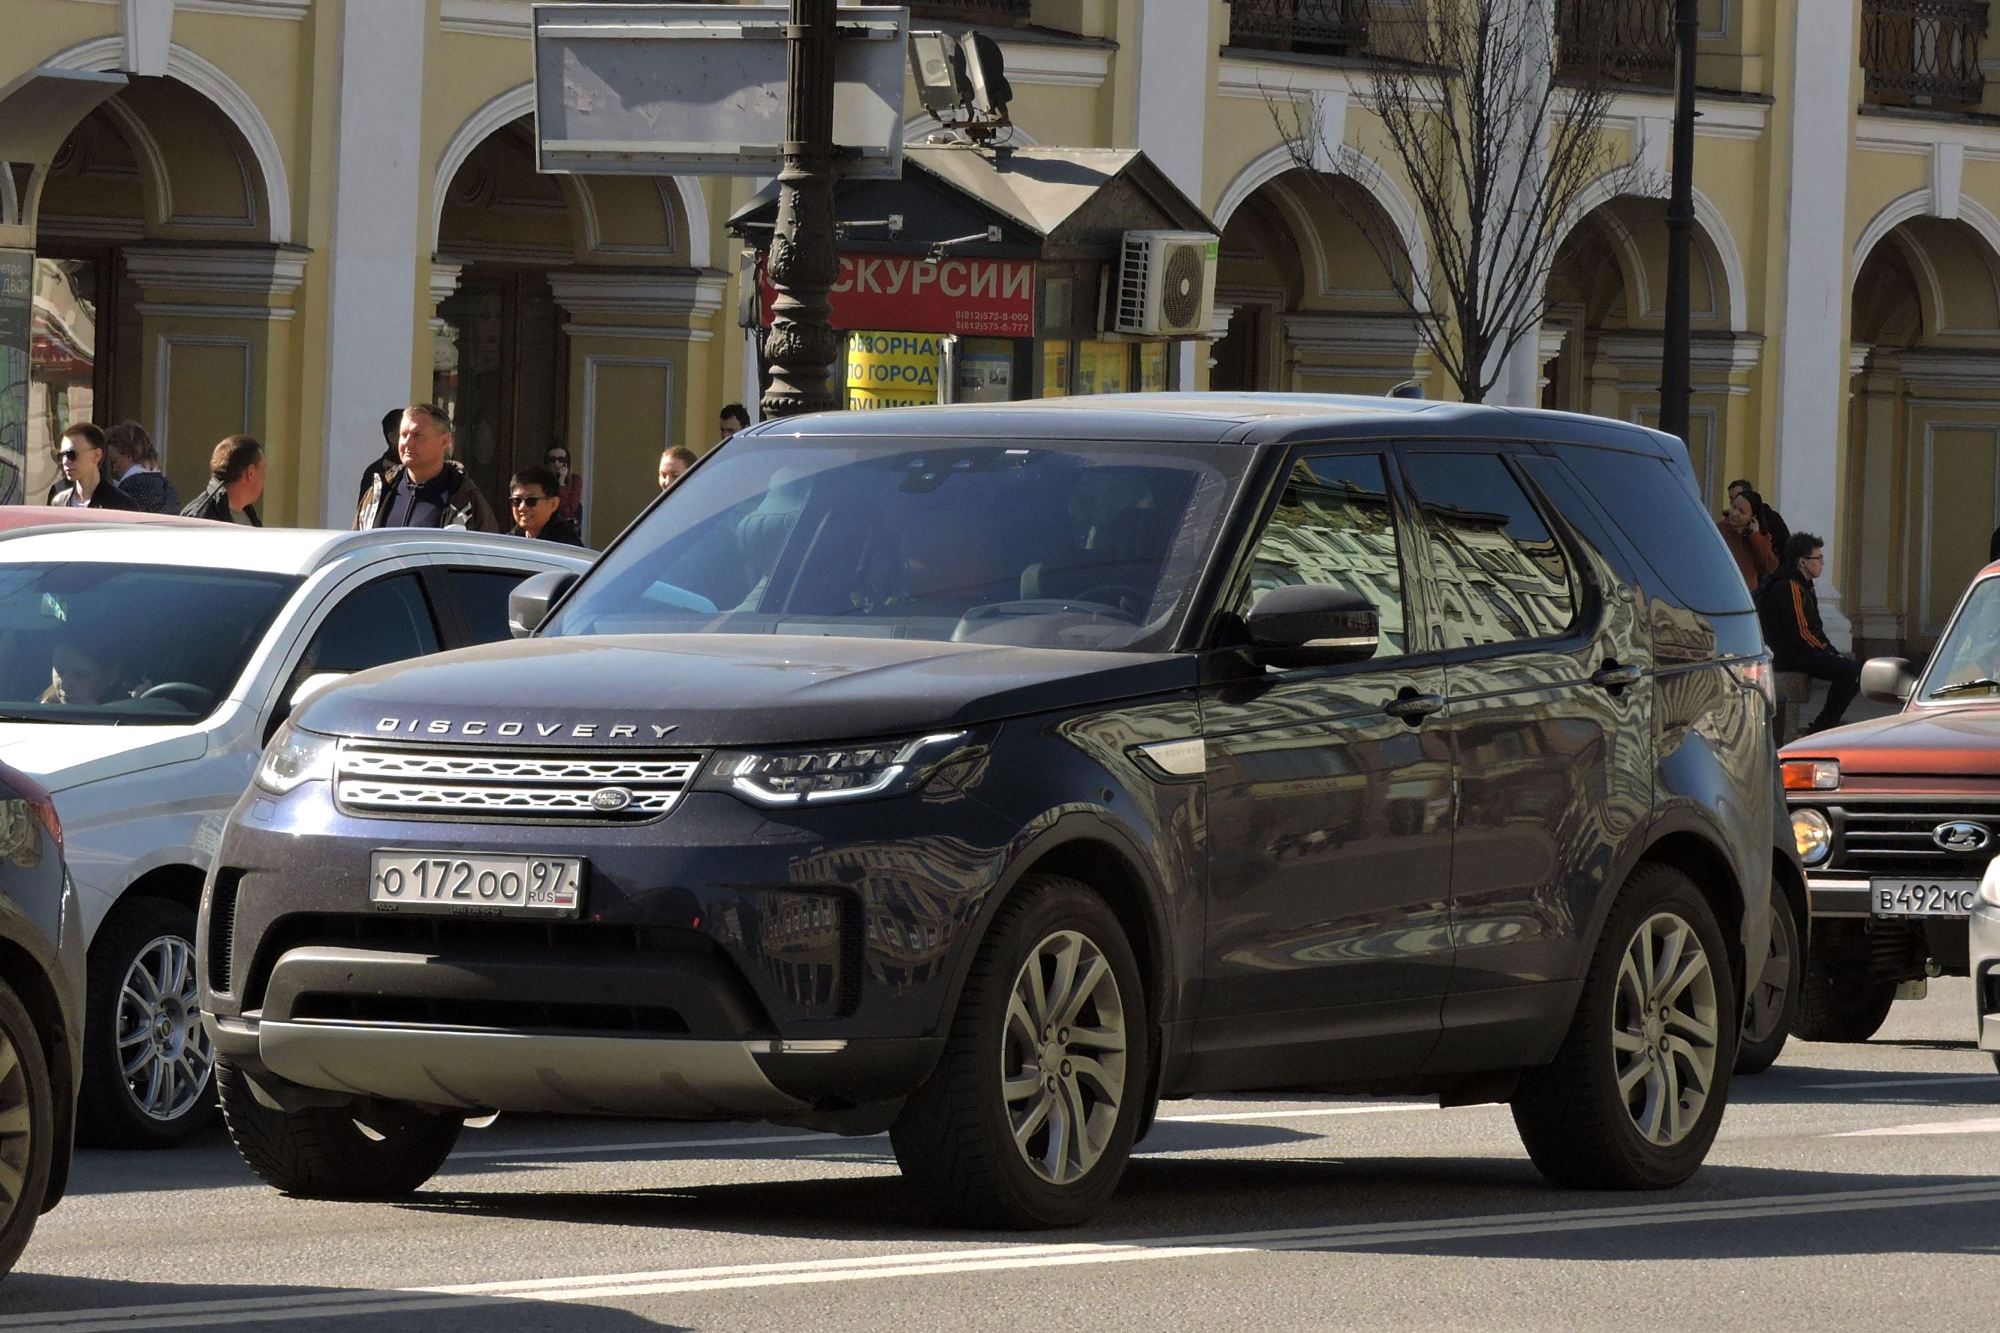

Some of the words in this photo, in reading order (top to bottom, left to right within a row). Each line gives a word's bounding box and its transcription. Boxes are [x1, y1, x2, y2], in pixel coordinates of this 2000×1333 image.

[0, 263, 23, 274] етро
[768, 258, 1030, 299] СКУРСИИ
[376, 717, 678, 739] DISCOVERY
[531, 861, 567, 891] 97
[528, 891, 554, 903] RUS
